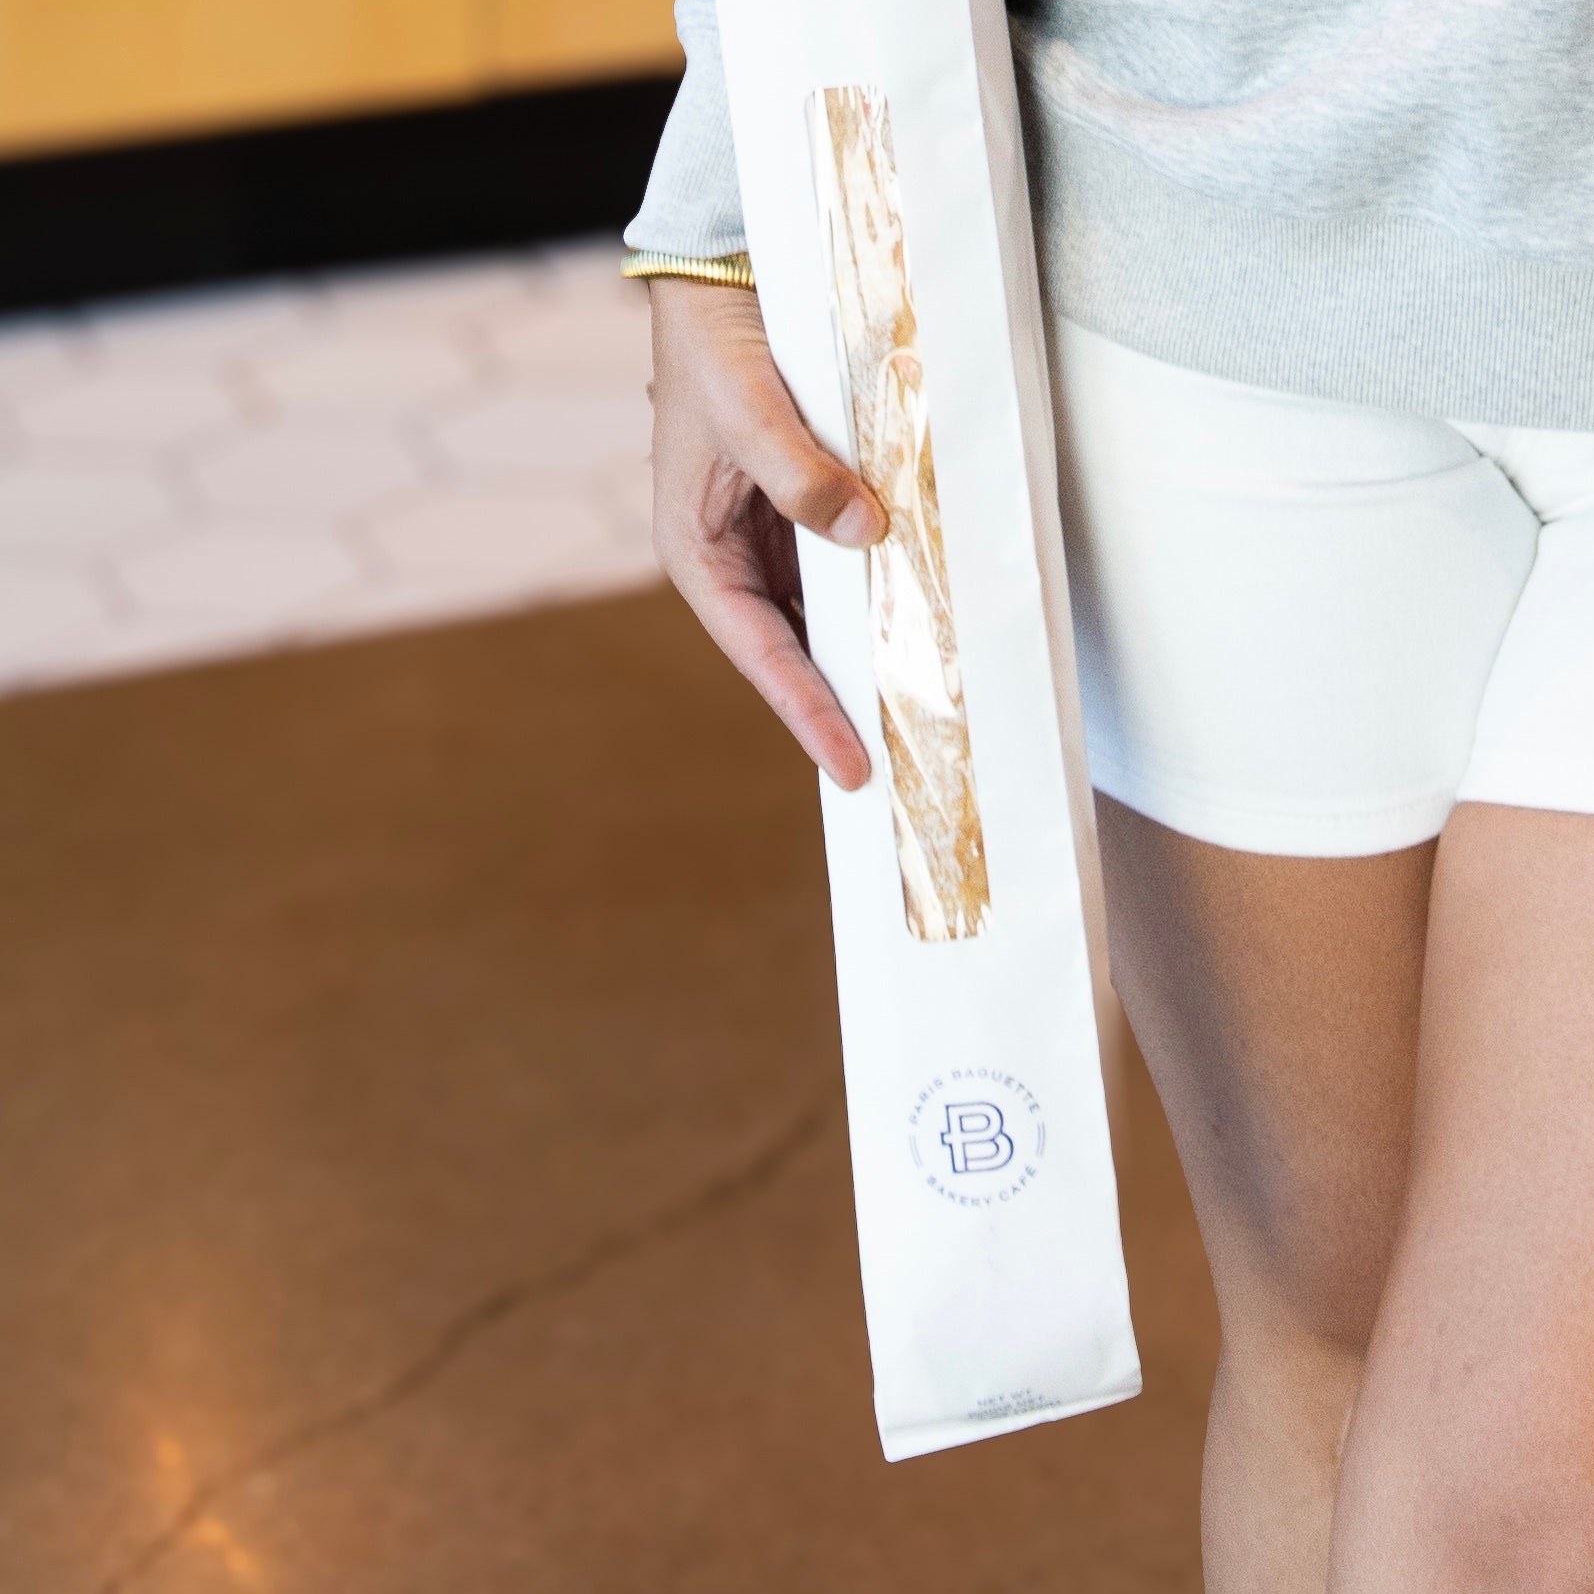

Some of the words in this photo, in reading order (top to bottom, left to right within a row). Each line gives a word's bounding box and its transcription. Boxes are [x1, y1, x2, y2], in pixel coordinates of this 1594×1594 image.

[908, 1077, 943, 1126] PARIS
[951, 1068, 1040, 1114] BAGUETTE
[927, 1175, 992, 1207] BAKERY
